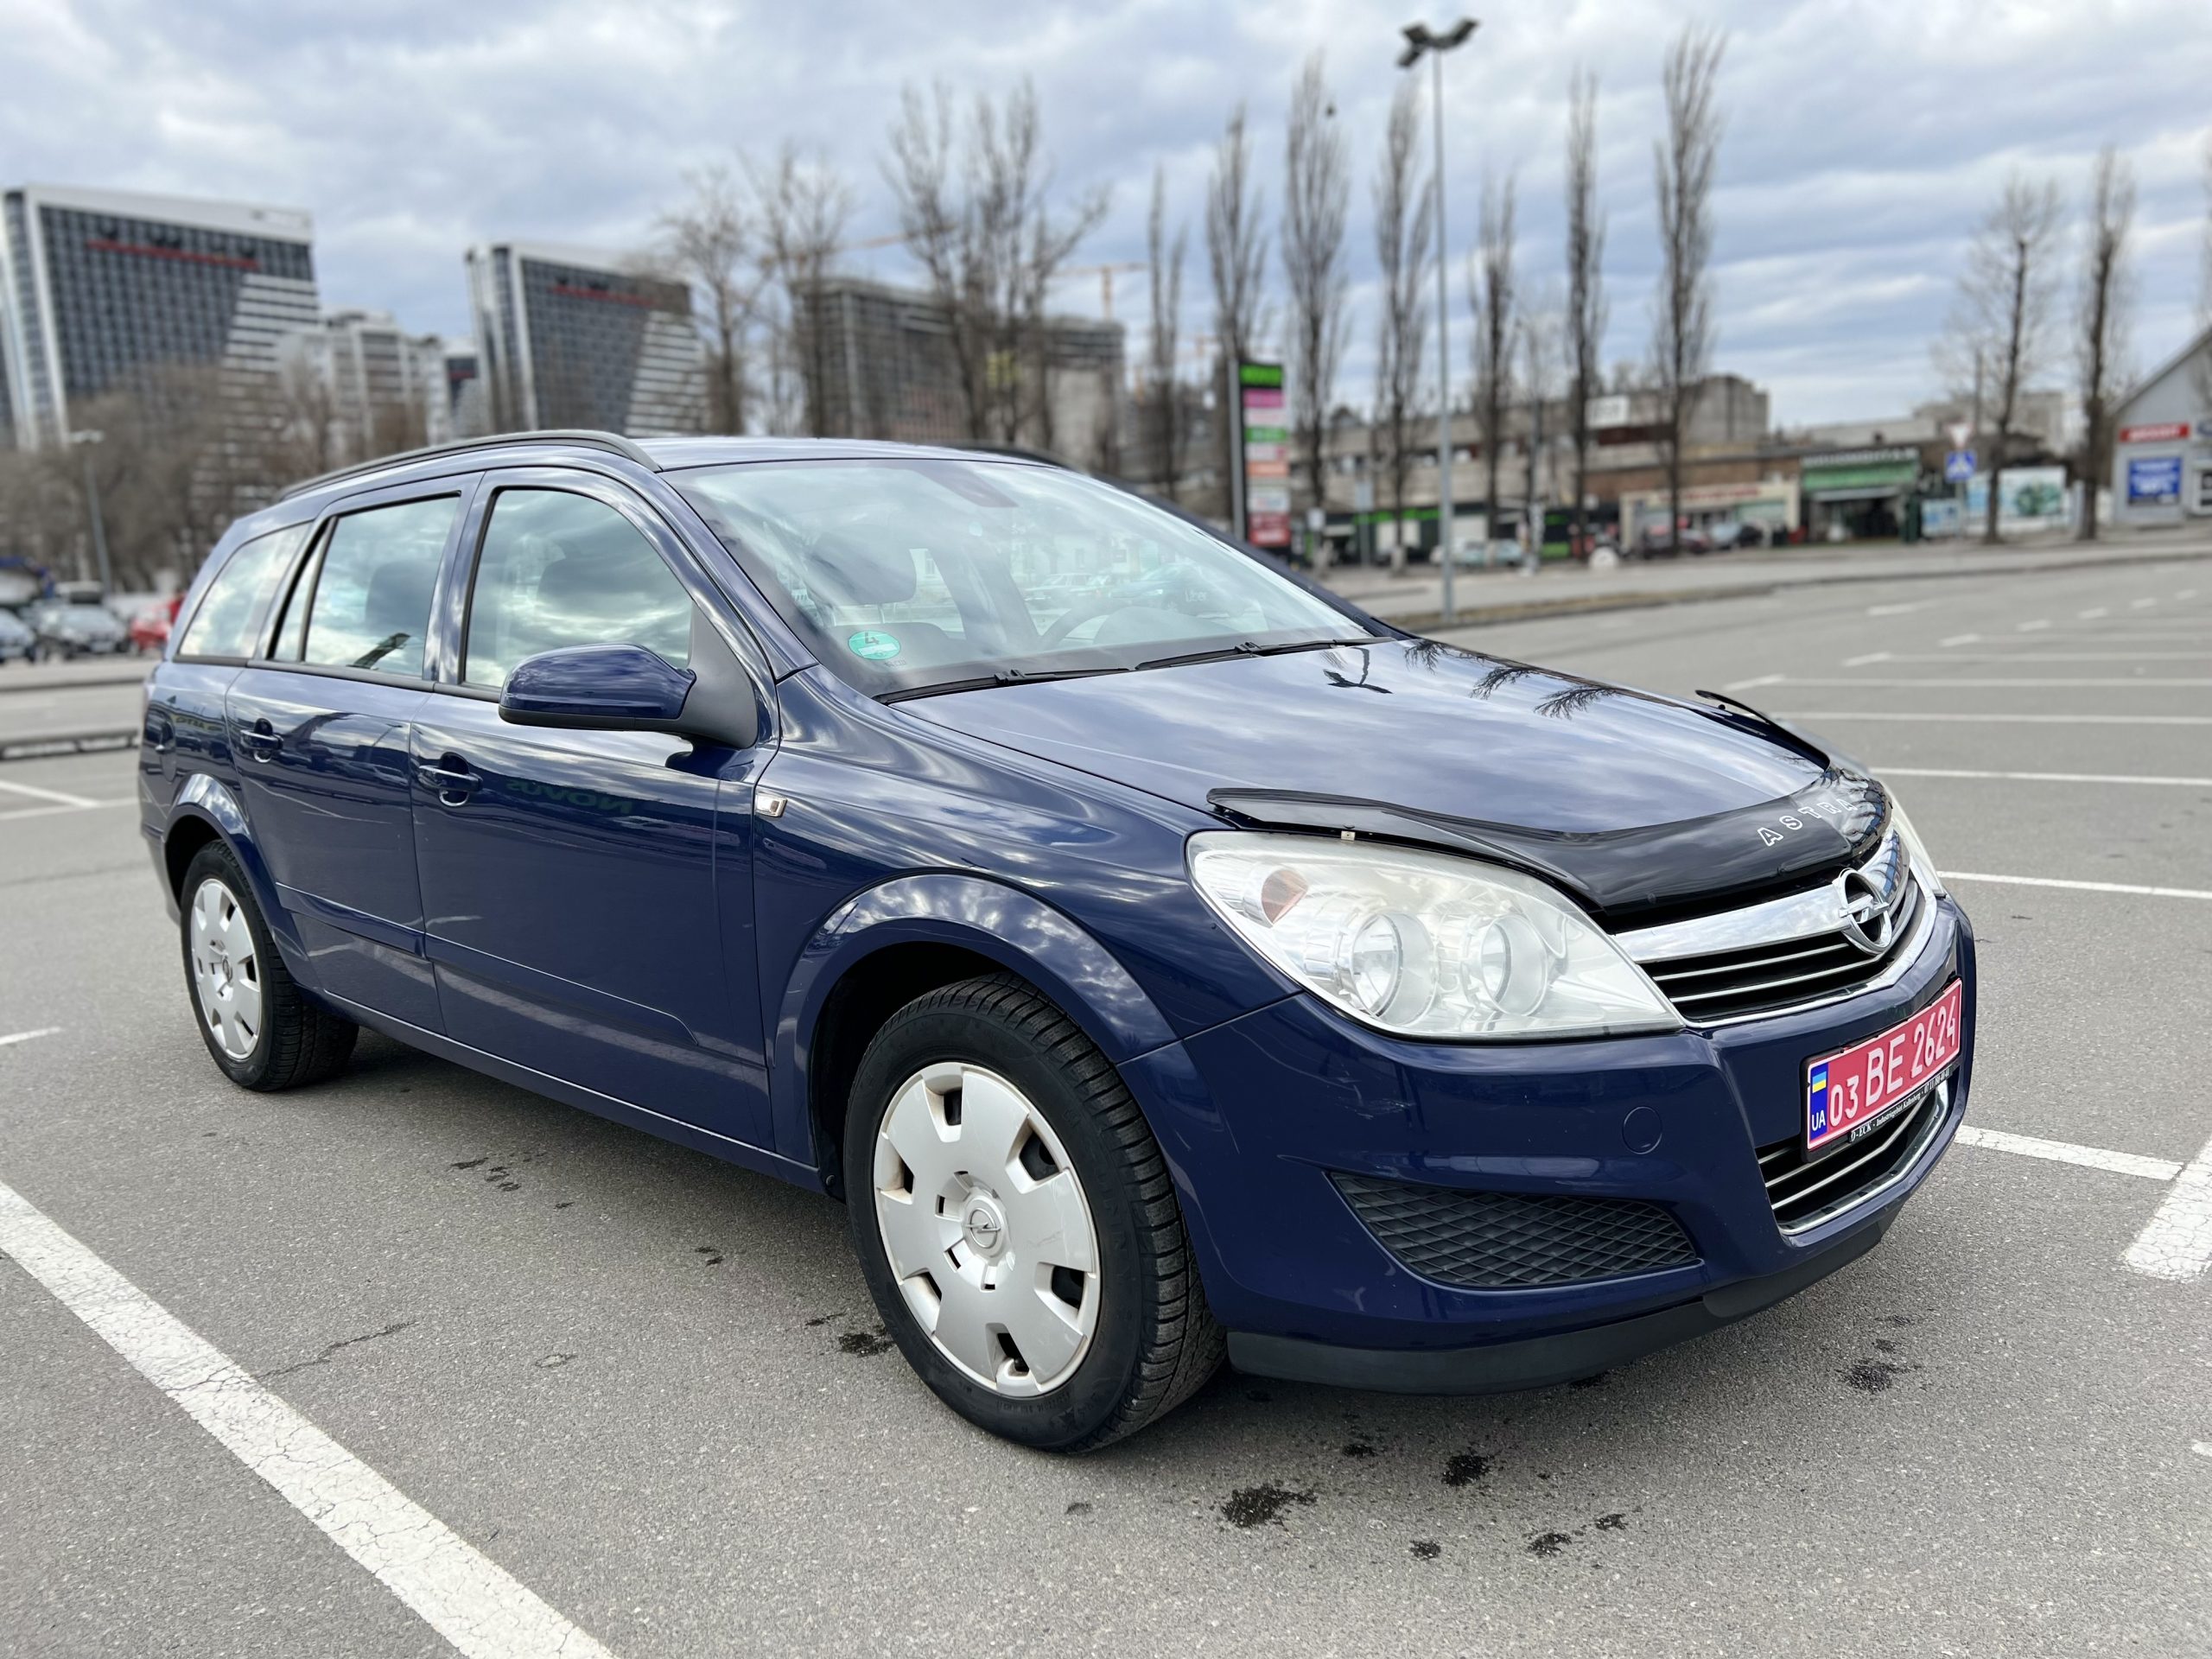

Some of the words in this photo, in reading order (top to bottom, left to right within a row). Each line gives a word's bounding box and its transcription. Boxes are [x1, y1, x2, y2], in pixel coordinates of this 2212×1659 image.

[1758, 798, 1858, 847] ASTRA
[1829, 1074, 1859, 1128] 03
[1865, 1033, 1906, 1108] BE
[1910, 995, 1956, 1079] 2624
[1811, 1109, 1827, 1132] UA
